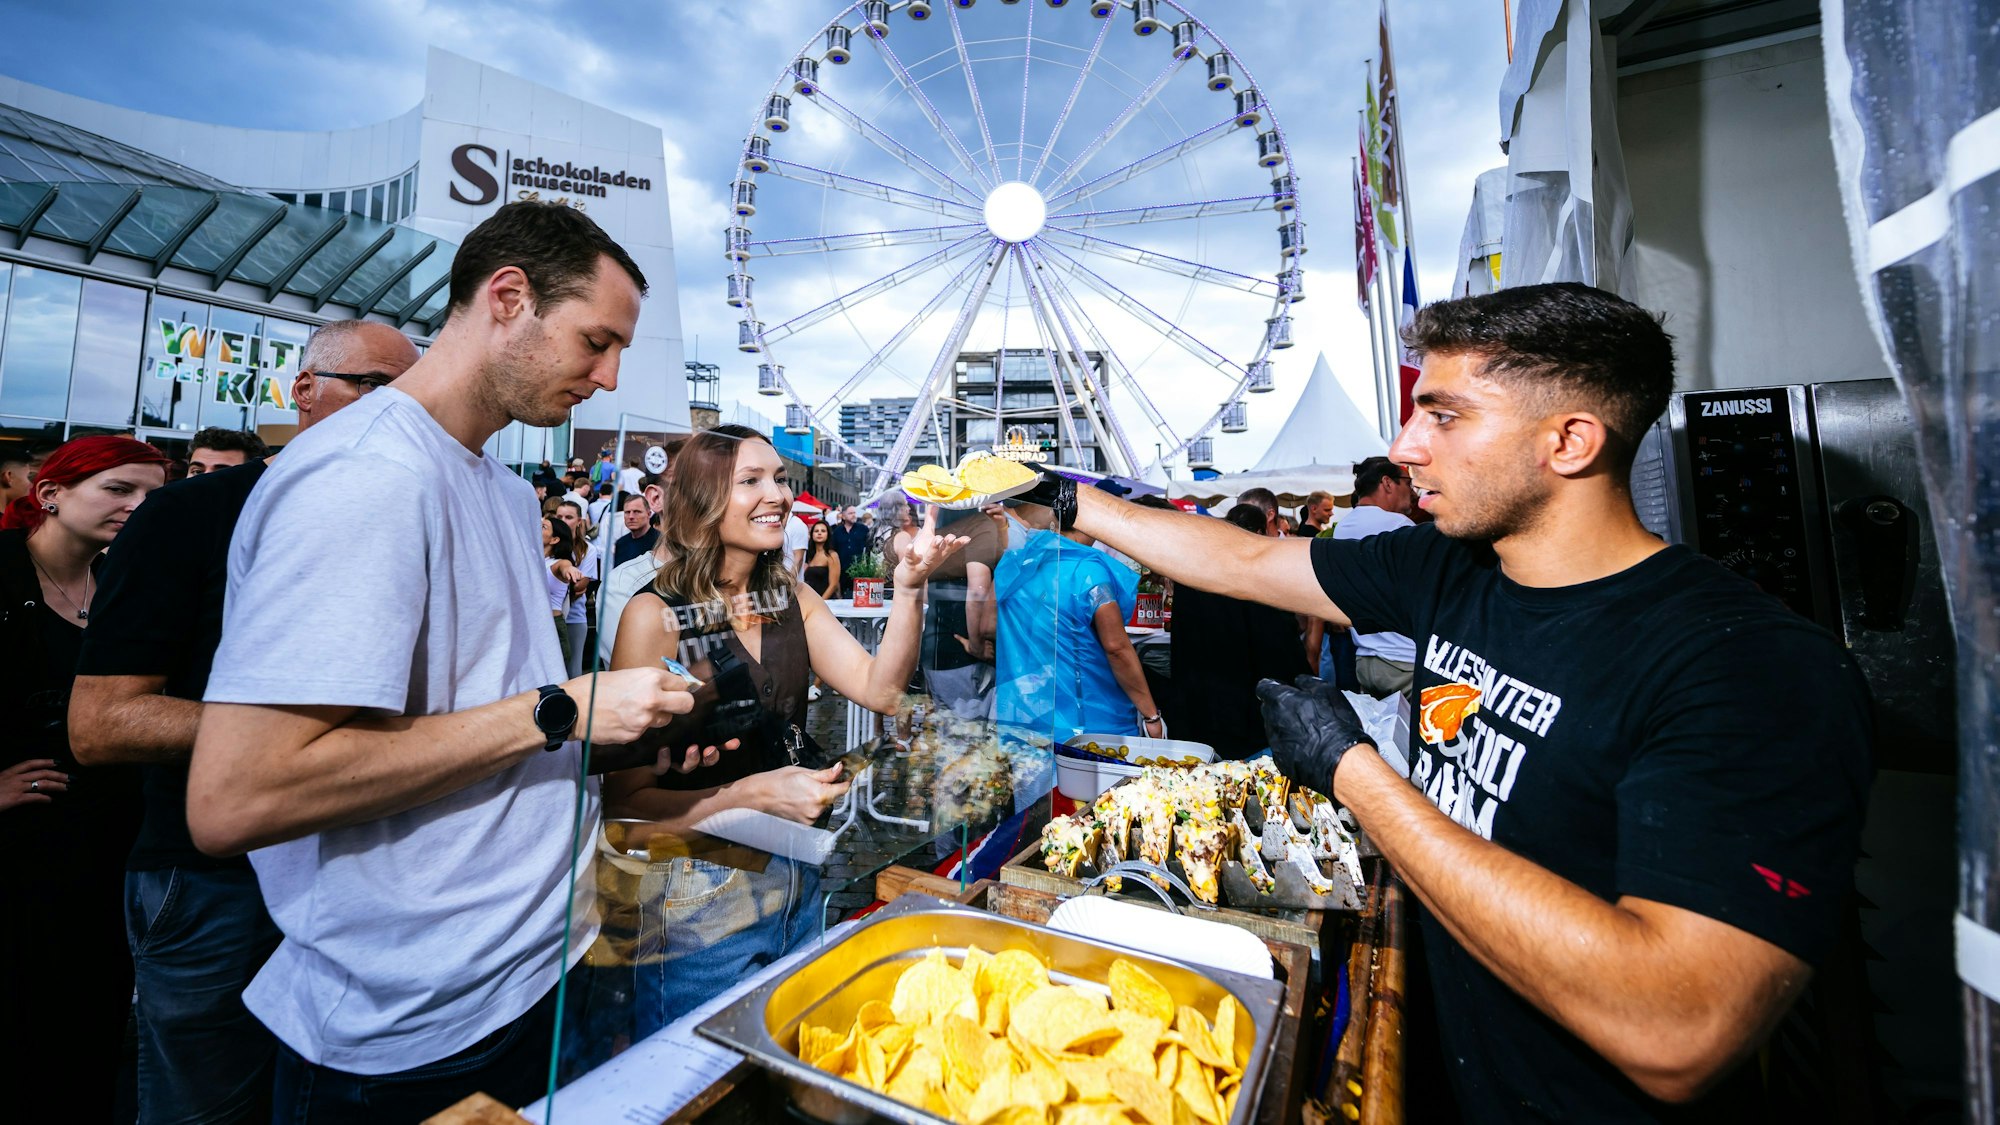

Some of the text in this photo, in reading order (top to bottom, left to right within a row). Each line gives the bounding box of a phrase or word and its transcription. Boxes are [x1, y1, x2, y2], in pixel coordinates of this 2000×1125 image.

[511, 171, 606, 197] museum
[512, 157, 651, 190] schokoladen
[156, 360, 209, 383] DES
[1701, 398, 1772, 417] ZANUSSI
[997, 452, 1048, 463] ESENRAD
